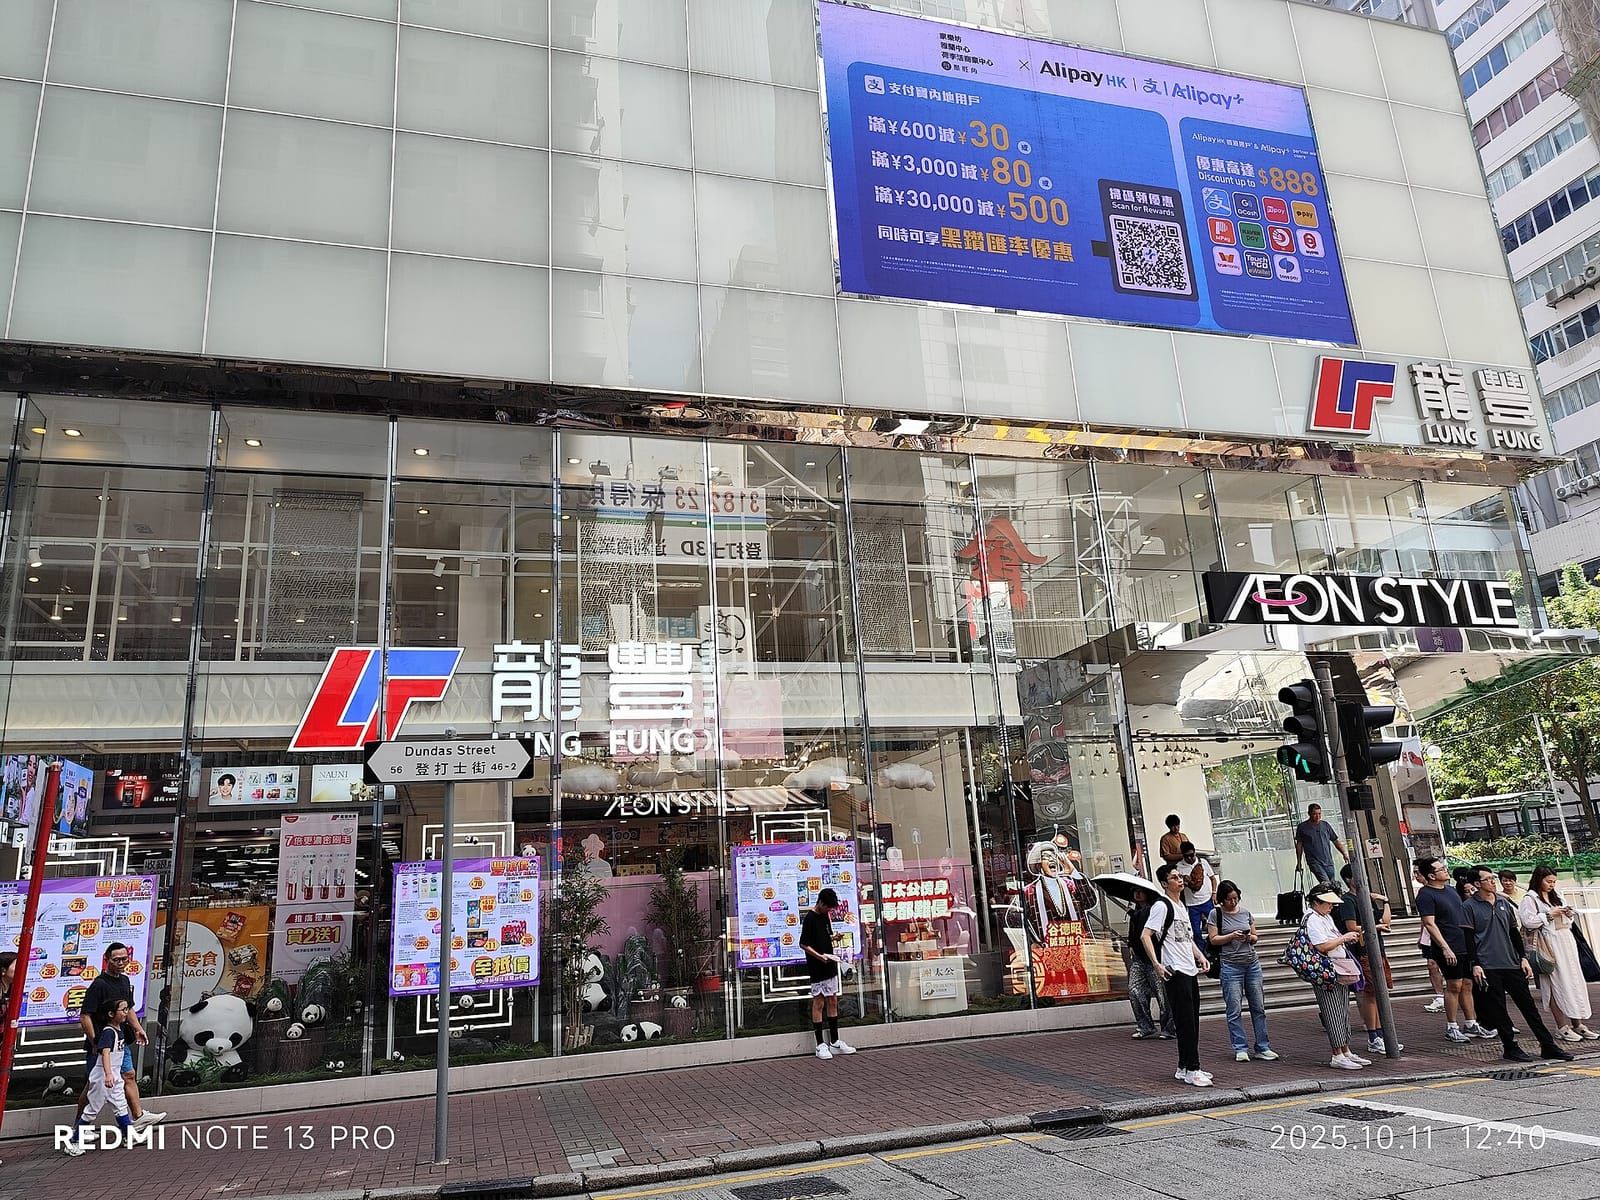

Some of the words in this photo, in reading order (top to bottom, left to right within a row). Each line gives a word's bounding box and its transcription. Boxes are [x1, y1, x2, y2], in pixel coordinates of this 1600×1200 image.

[1200, 172, 1234, 184] Discount
[1236, 178, 1246, 188] up
[1247, 179, 1256, 188] to
[1257, 166, 1318, 197] $888
[1112, 201, 1130, 210] Scan
[1131, 203, 1142, 212] for
[1143, 205, 1175, 216] Rewards
[1408, 362, 1538, 427] 龍豐
[1421, 424, 1480, 448] LUNG
[1488, 428, 1544, 452] FUNG
[1372, 577, 1519, 625] STYLE
[492, 639, 693, 721] 龍豐
[609, 728, 697, 755] FUNG
[405, 746, 452, 757] Dundas
[457, 744, 496, 755] Street
[390, 766, 403, 774] 56
[415, 761, 486, 776] 登打士街
[490, 762, 517, 771] 46-2
[17, 832, 24, 844] 3
[286, 926, 340, 945] 買2送1
[1048, 922, 1082, 936] 谷德昭
[181, 968, 216, 978] NACKS
